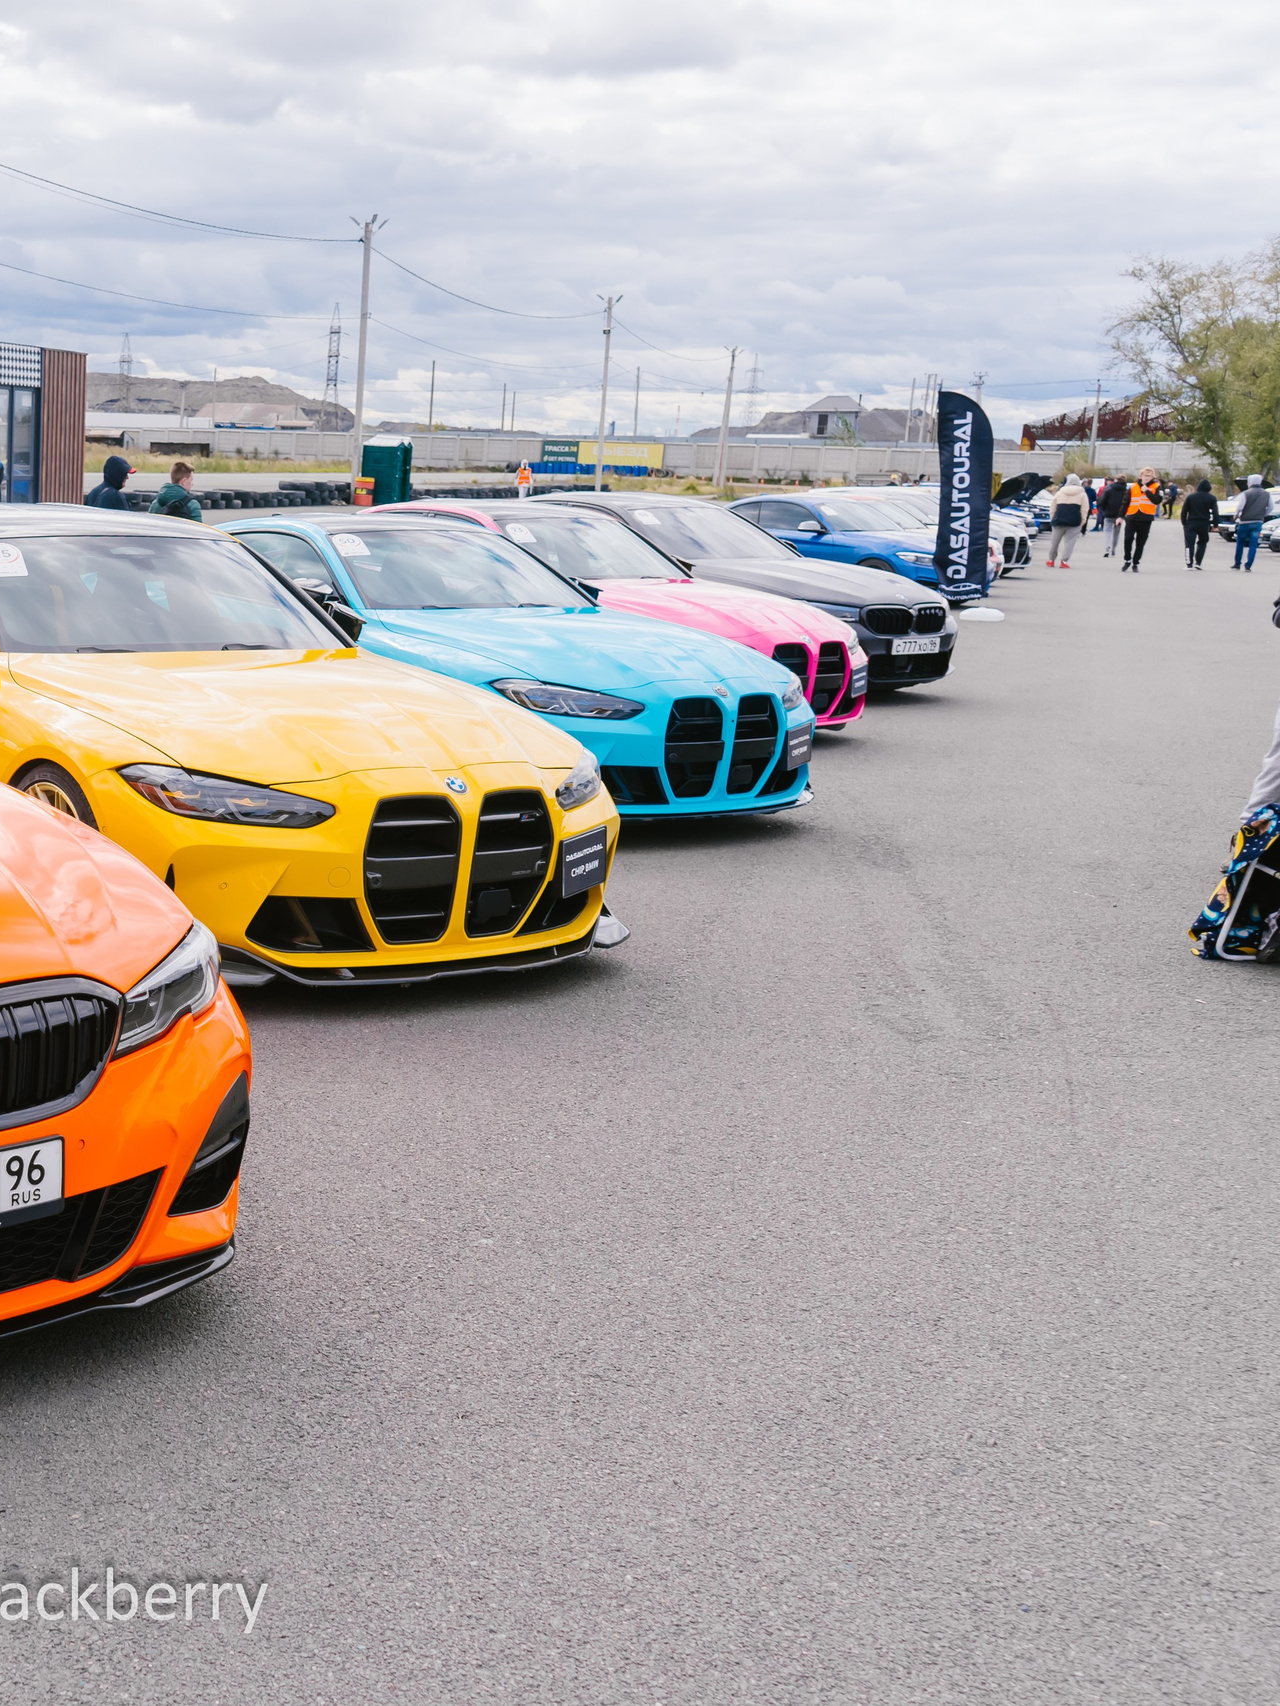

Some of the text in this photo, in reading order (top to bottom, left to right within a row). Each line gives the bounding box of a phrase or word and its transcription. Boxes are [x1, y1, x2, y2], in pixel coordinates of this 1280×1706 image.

[946, 411, 973, 579] DASAUTOURAL
[565, 843, 603, 862] DASAUTOURAL
[6, 1149, 45, 1191] 96
[11, 1188, 41, 1207] RUS
